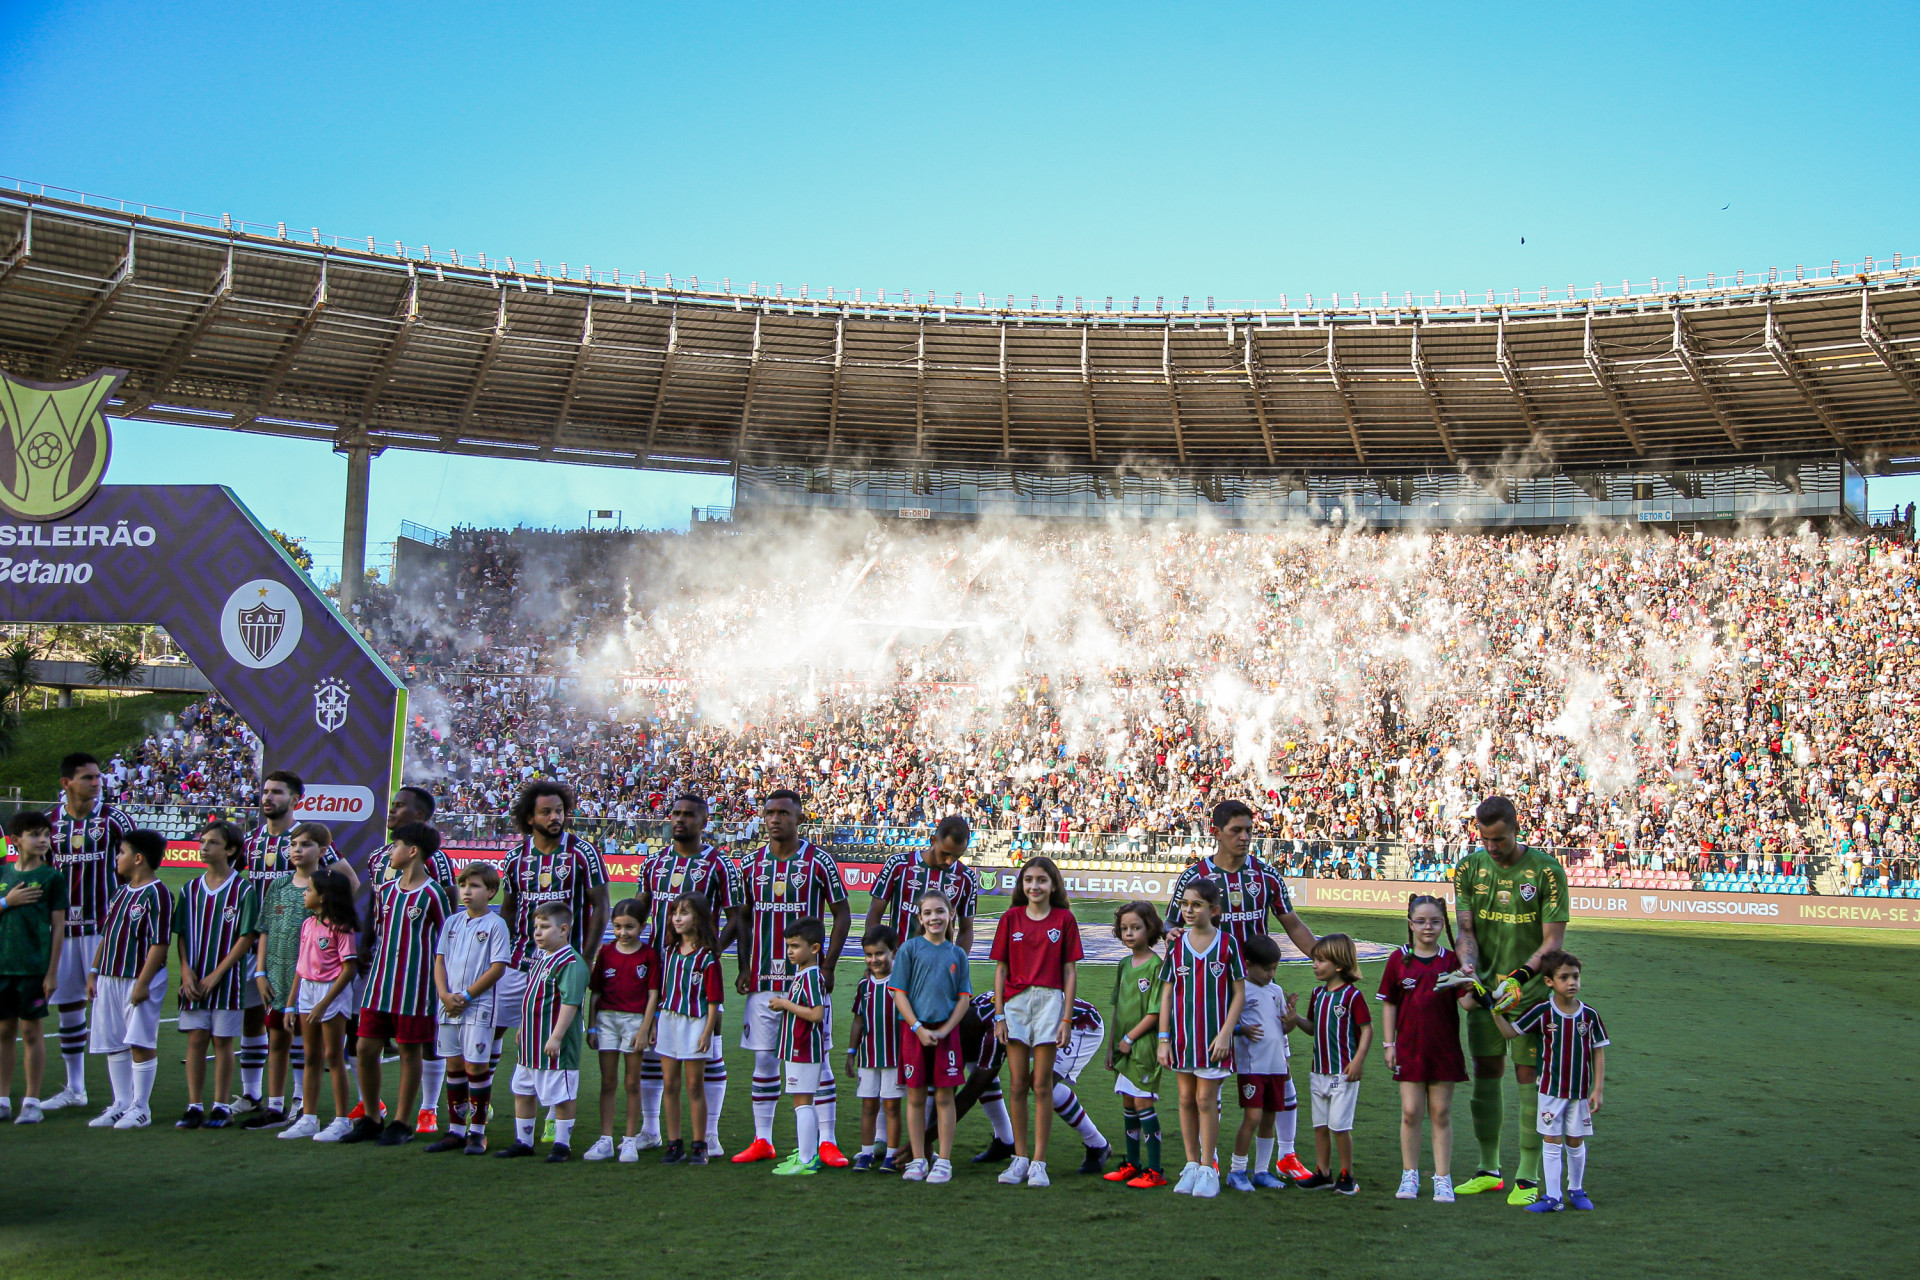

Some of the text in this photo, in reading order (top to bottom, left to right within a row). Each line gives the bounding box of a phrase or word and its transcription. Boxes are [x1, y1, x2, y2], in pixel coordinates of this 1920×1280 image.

[900, 509, 929, 518] SETOR D
[1639, 511, 1671, 521] SETOR C
[0, 520, 157, 547] SILEIRÃO
[325, 703, 339, 711] CBF
[54, 850, 106, 863] SUPERBET
[576, 841, 599, 875] ZINZANE
[435, 851, 449, 881] NZANE
[816, 852, 840, 889] ZINZANE
[880, 854, 907, 885] ZINZANE
[1543, 866, 1558, 908] ZINZANE
[522, 890, 572, 901] SUPERBET
[755, 902, 807, 913] SUPERBET
[1570, 897, 1628, 912] EDU.BR
[1220, 909, 1264, 923] UPERBET
[1479, 909, 1537, 925] SUPERBET
[1799, 905, 1909, 922] INSCREVA-SE
[948, 1050, 956, 1066] 9
